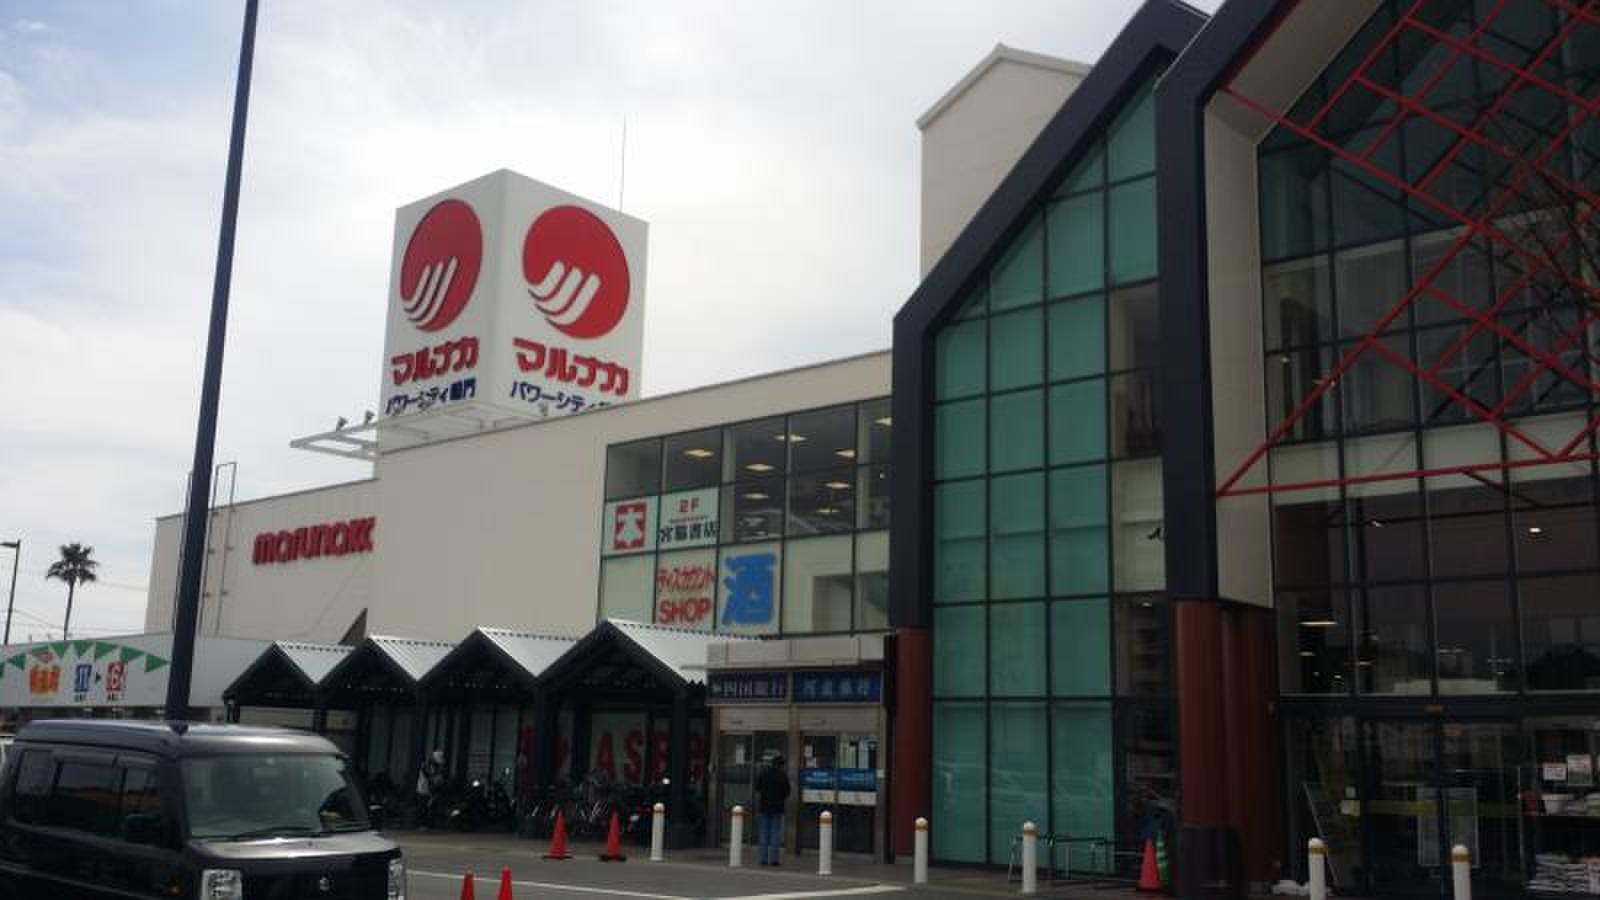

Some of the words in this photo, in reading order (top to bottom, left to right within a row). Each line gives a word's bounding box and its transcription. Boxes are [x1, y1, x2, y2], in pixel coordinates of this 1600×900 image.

[391, 336, 479, 386] マルナカ
[512, 337, 629, 396] マルナカ
[658, 598, 712, 625] SHOP
[721, 553, 777, 625] 酒
